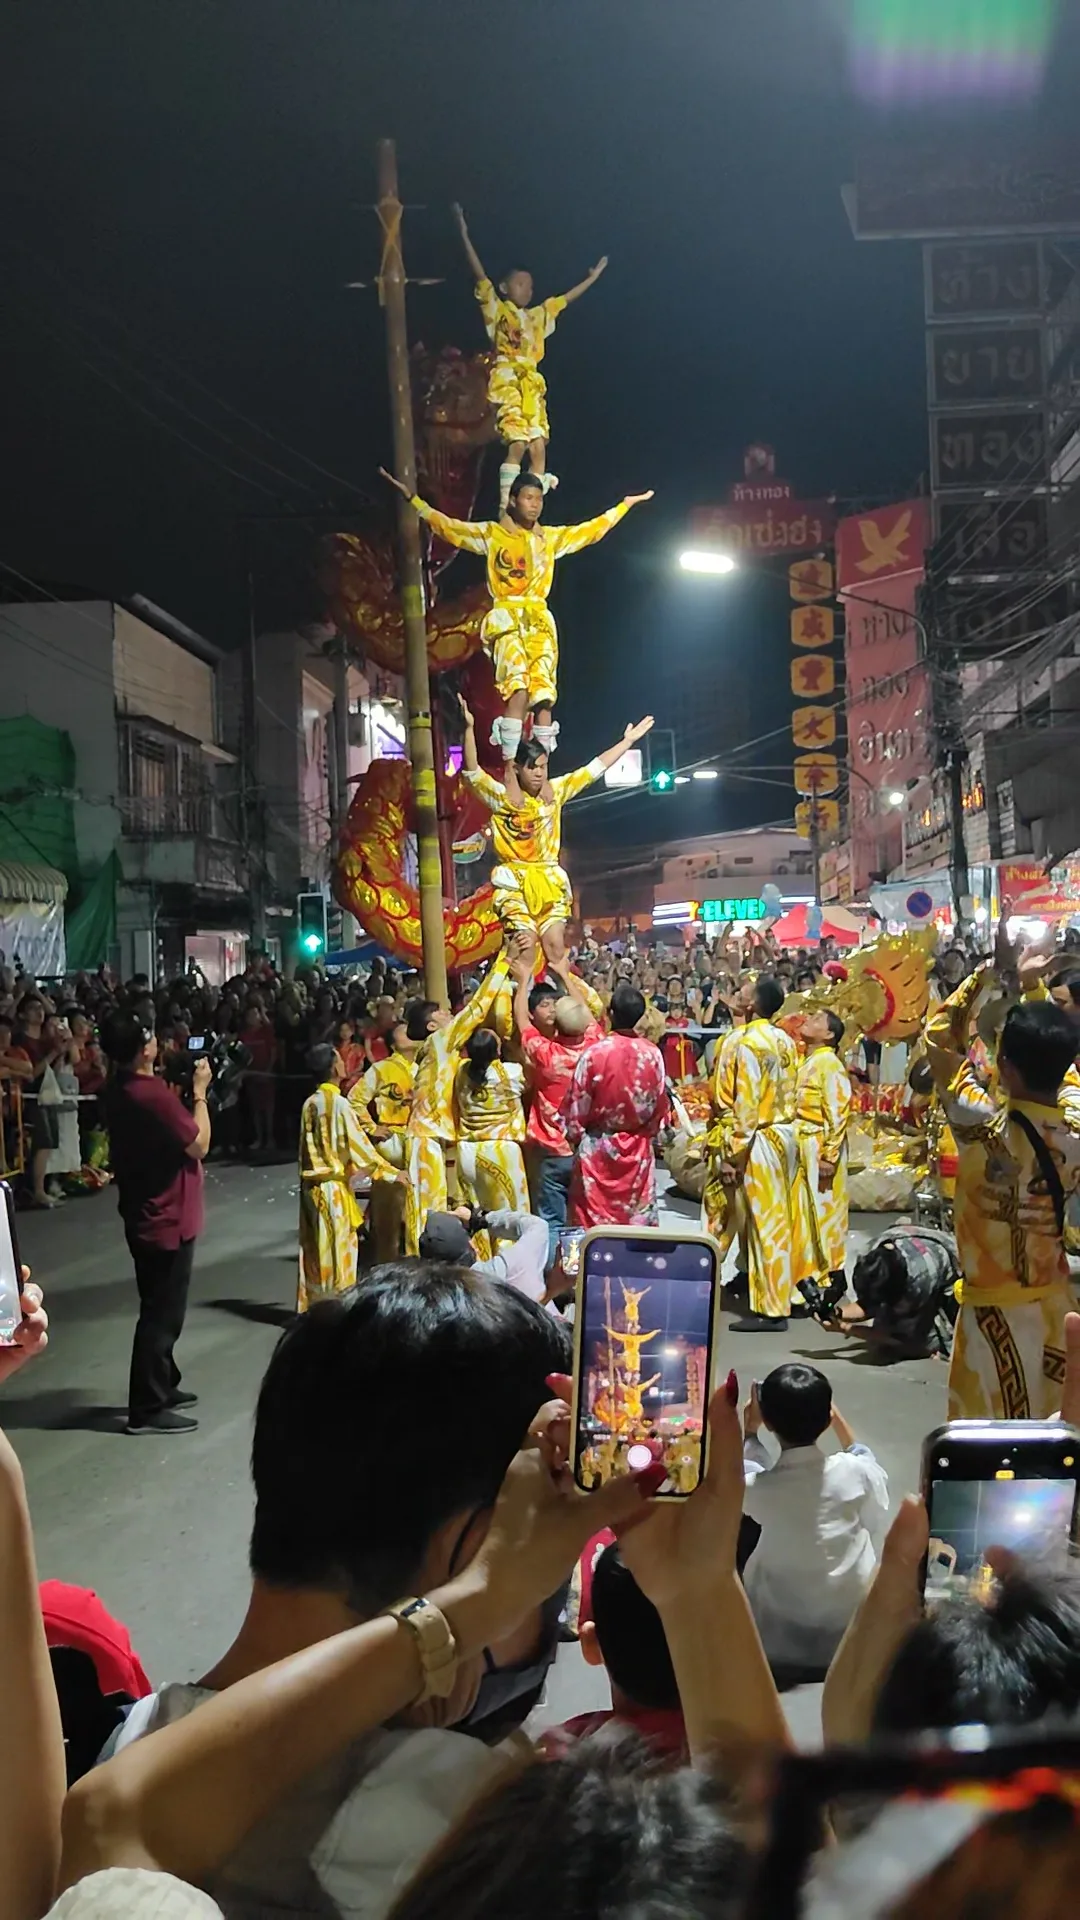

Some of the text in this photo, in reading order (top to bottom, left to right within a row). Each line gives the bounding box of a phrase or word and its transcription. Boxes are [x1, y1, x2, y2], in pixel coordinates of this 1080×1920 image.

[937, 250, 1034, 304] ห้าง
[942, 345, 1035, 385] ขาย
[940, 429, 1042, 470] ทอง
[733, 482, 790, 502] ห้างทอง
